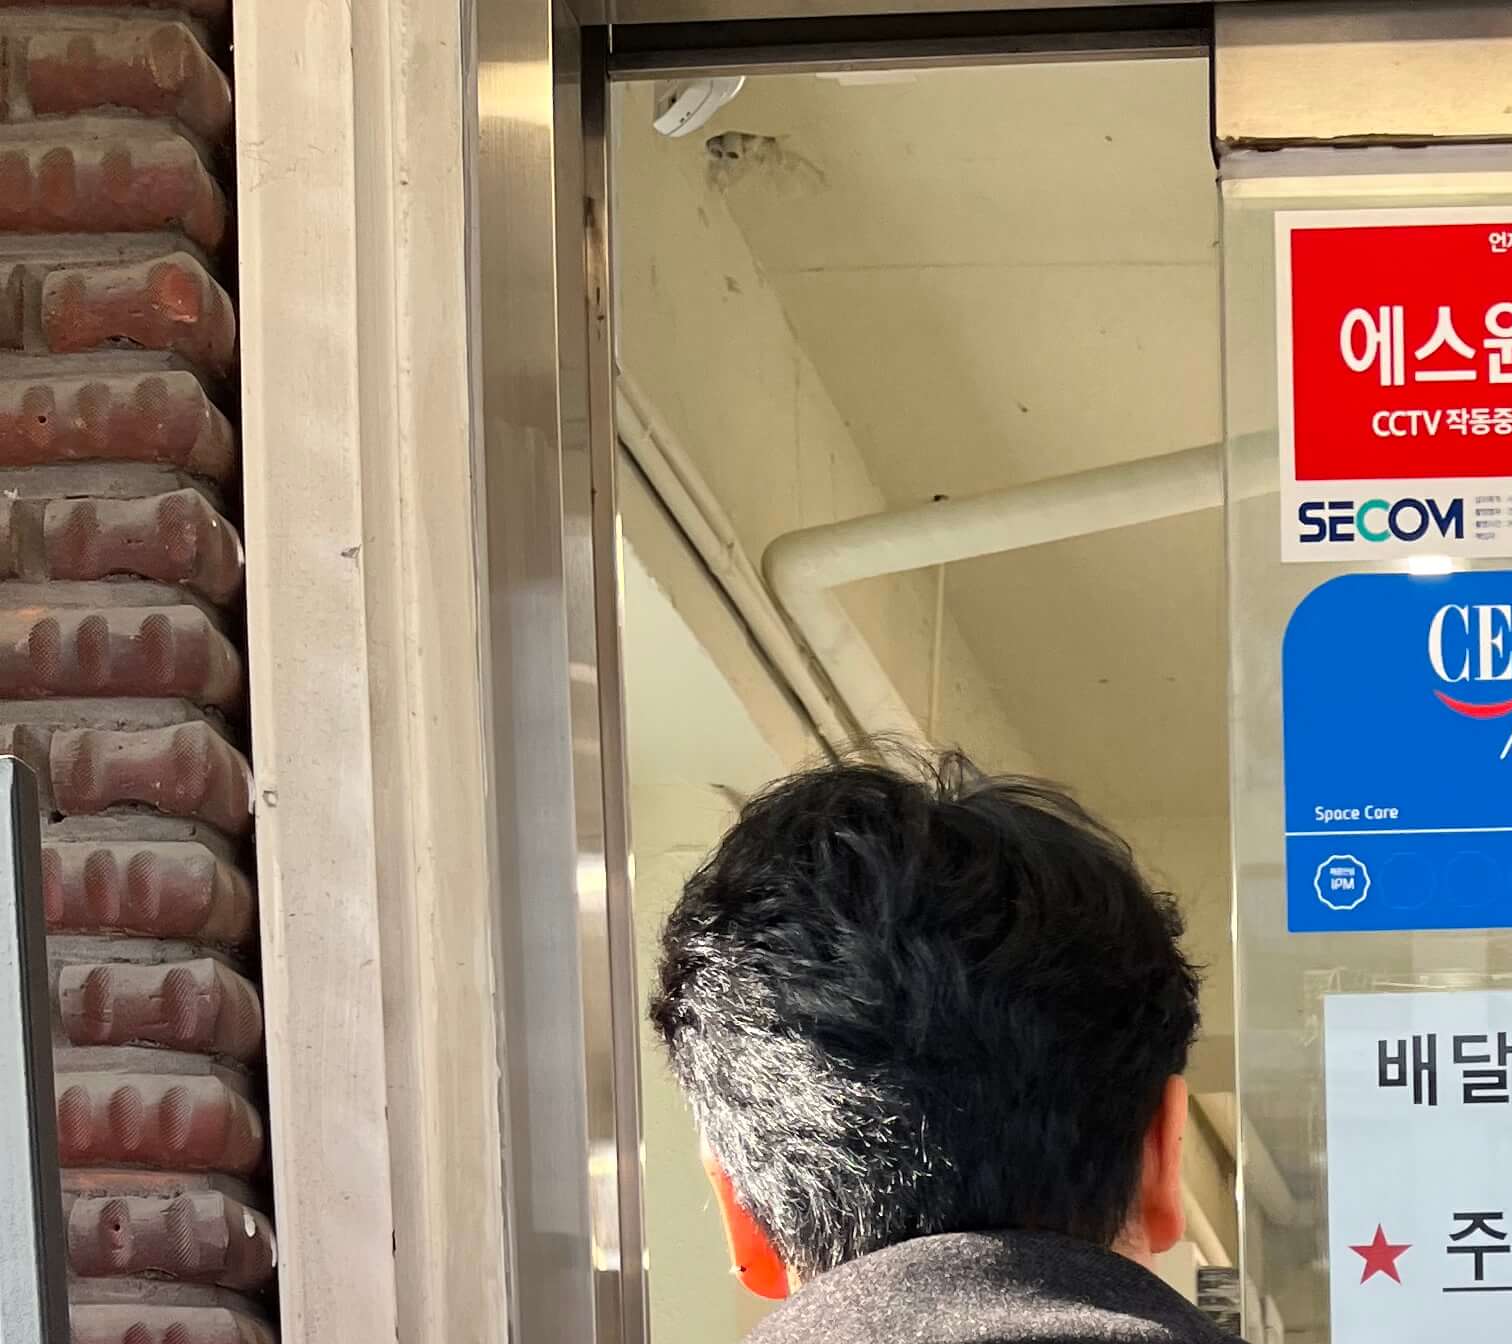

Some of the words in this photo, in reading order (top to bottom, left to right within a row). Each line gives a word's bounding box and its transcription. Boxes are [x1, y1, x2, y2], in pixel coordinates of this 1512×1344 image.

[1372, 411, 1442, 437] CCTV
[1298, 498, 1464, 543] SECOM
[1315, 805, 1360, 823] Space
[1365, 804, 1399, 820] Care
